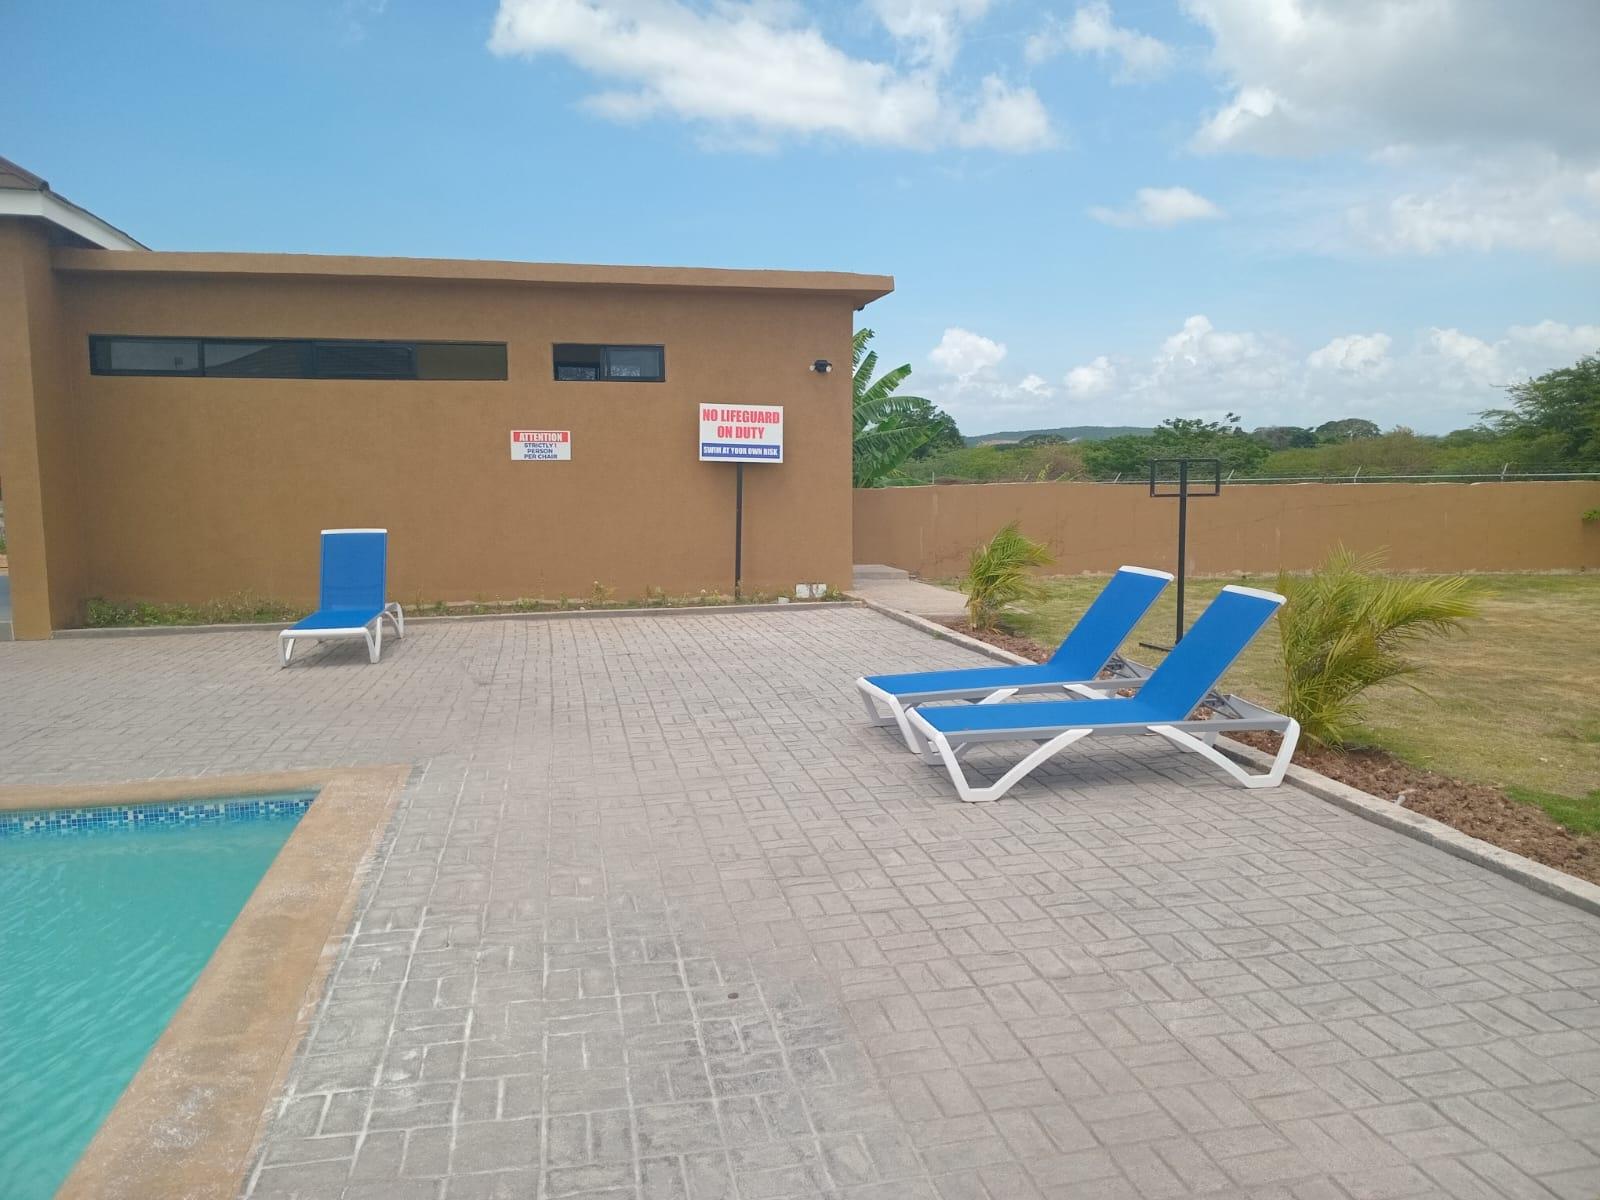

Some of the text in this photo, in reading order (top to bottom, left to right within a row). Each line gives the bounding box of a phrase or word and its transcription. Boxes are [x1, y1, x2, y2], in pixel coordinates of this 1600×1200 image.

[703, 408, 780, 424] NO LIFEGUARD
[520, 432, 562, 442] ATTENTION
[718, 426, 765, 439] ON DUTY
